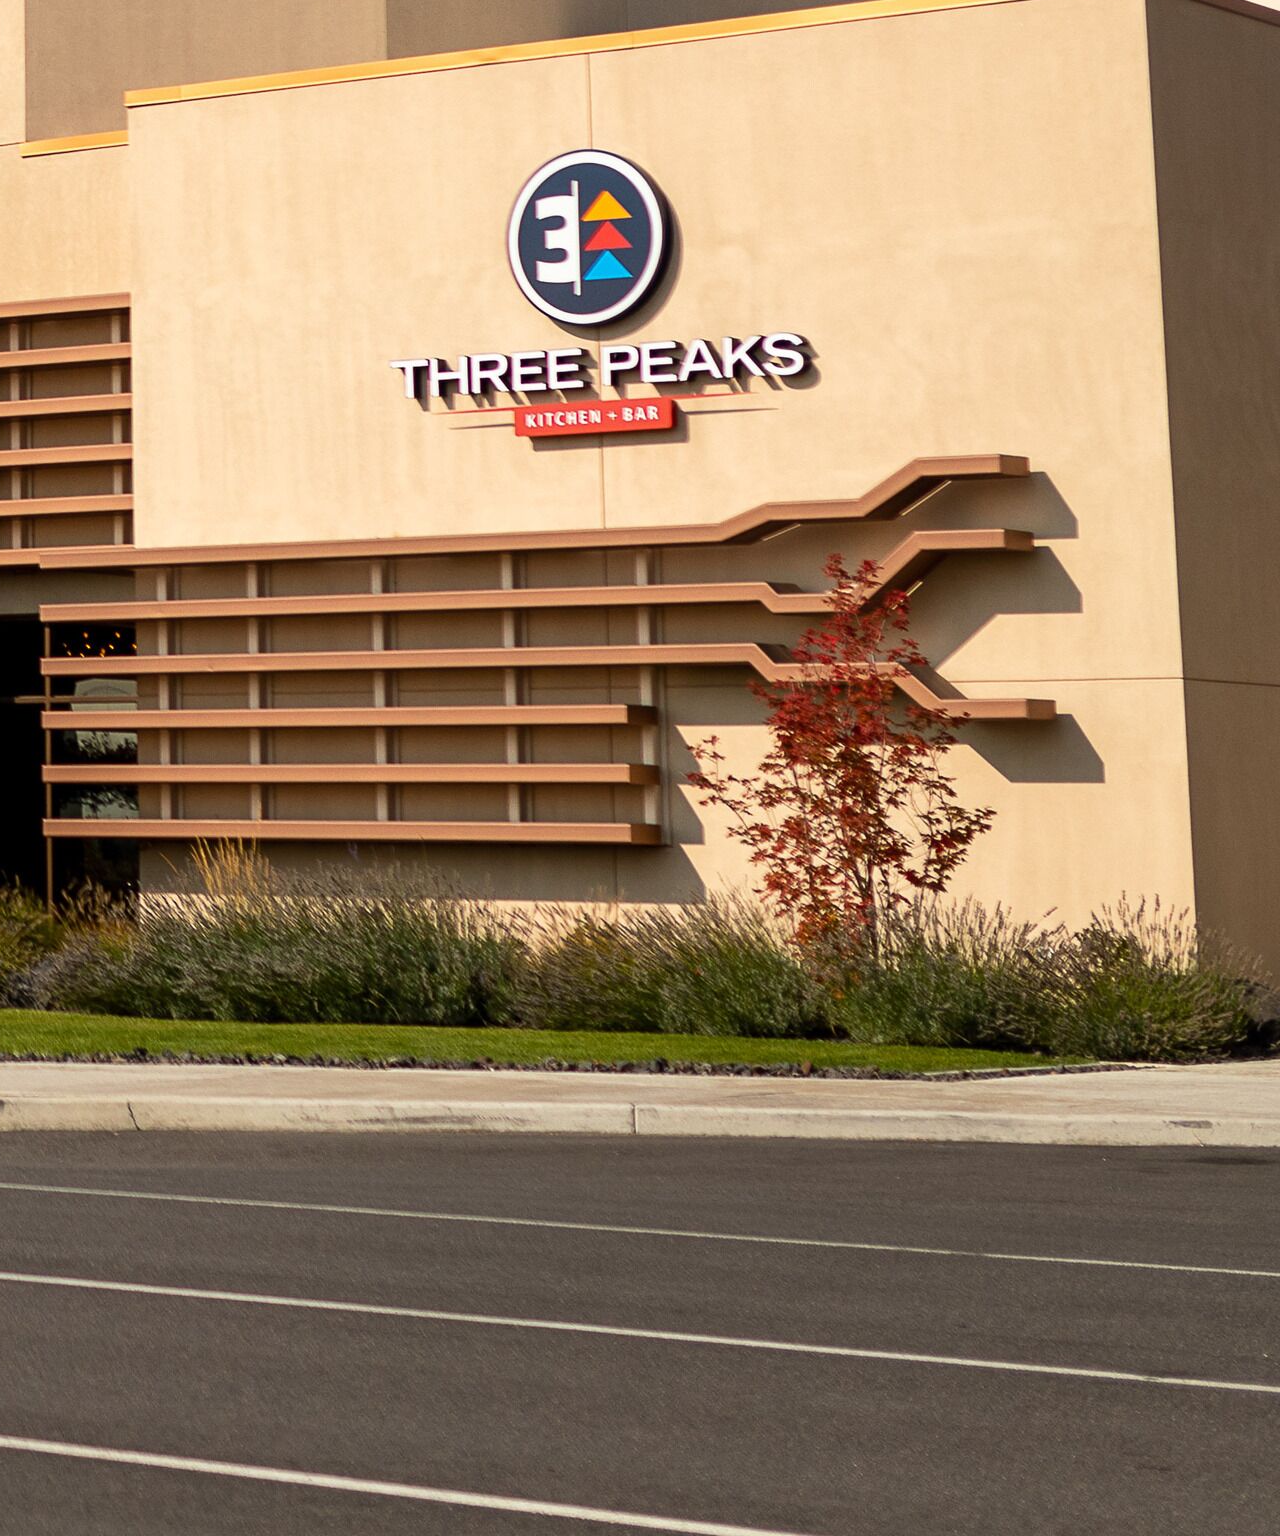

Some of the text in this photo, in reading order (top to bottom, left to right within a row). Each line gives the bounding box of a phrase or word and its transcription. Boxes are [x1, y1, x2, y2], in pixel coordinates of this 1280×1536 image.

[390, 332, 805, 399] THREE PEAKS
[525, 409, 602, 428] KITCHEN
[621, 405, 659, 422] BAR
